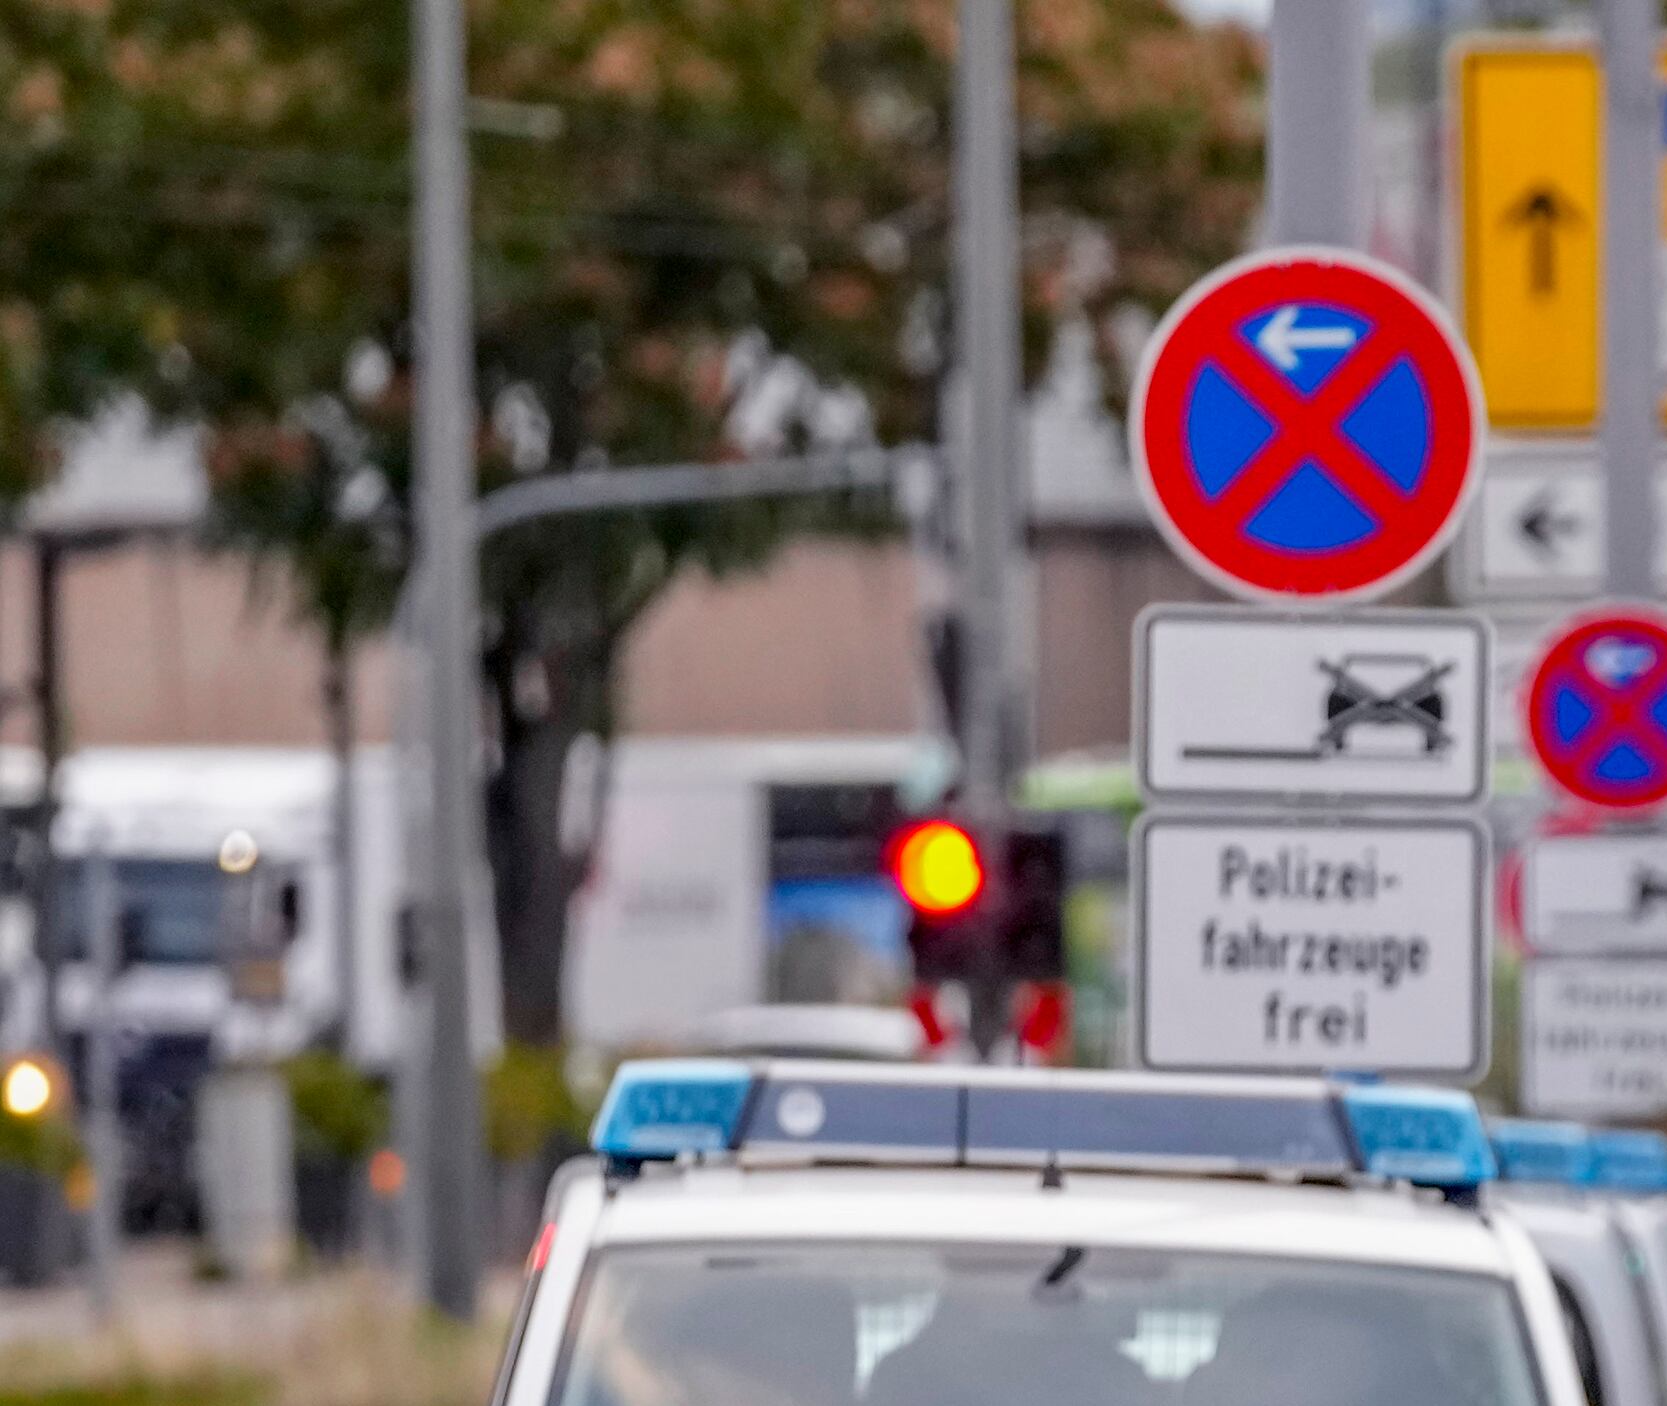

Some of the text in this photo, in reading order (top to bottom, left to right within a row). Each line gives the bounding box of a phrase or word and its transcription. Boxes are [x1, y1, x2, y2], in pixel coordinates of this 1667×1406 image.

[1219, 846, 1399, 900] Polizei-
[1201, 917, 1429, 988] fahrzeuge
[1263, 989, 1367, 1043] frei
